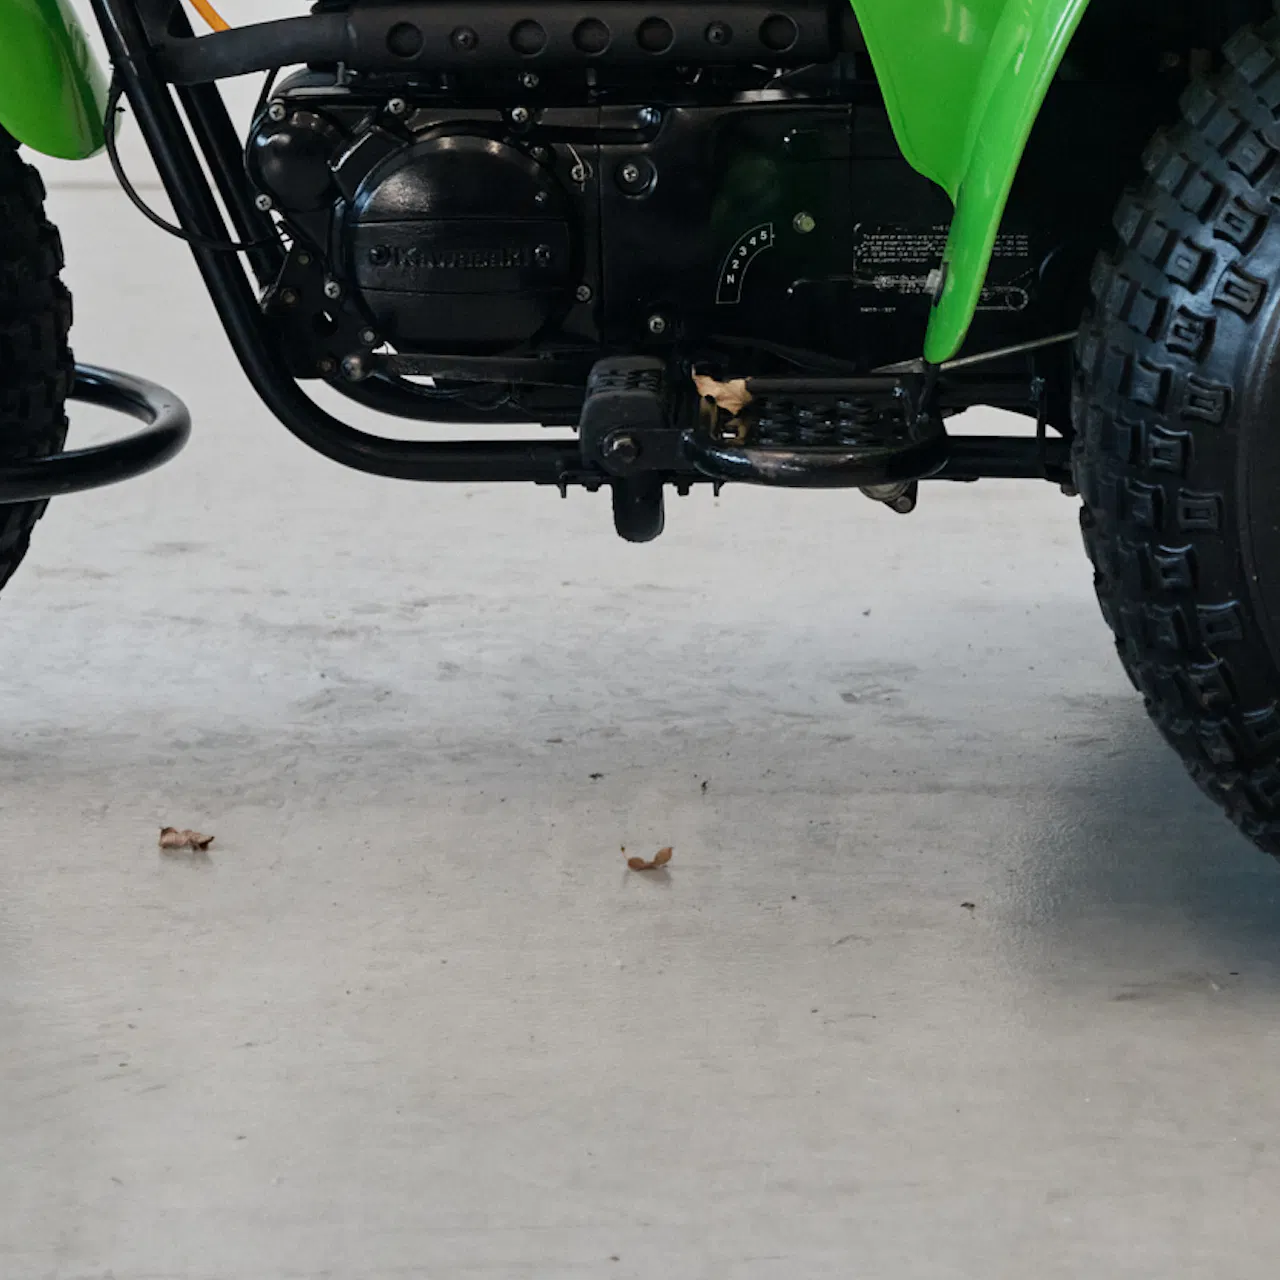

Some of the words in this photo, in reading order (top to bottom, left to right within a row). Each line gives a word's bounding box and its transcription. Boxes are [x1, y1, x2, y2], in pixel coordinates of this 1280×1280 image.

[726, 273, 735, 284] N
[732, 259, 740, 270] 2
[739, 245, 748, 257] 3
[749, 236, 757, 247] 4
[760, 230, 768, 241] 5
